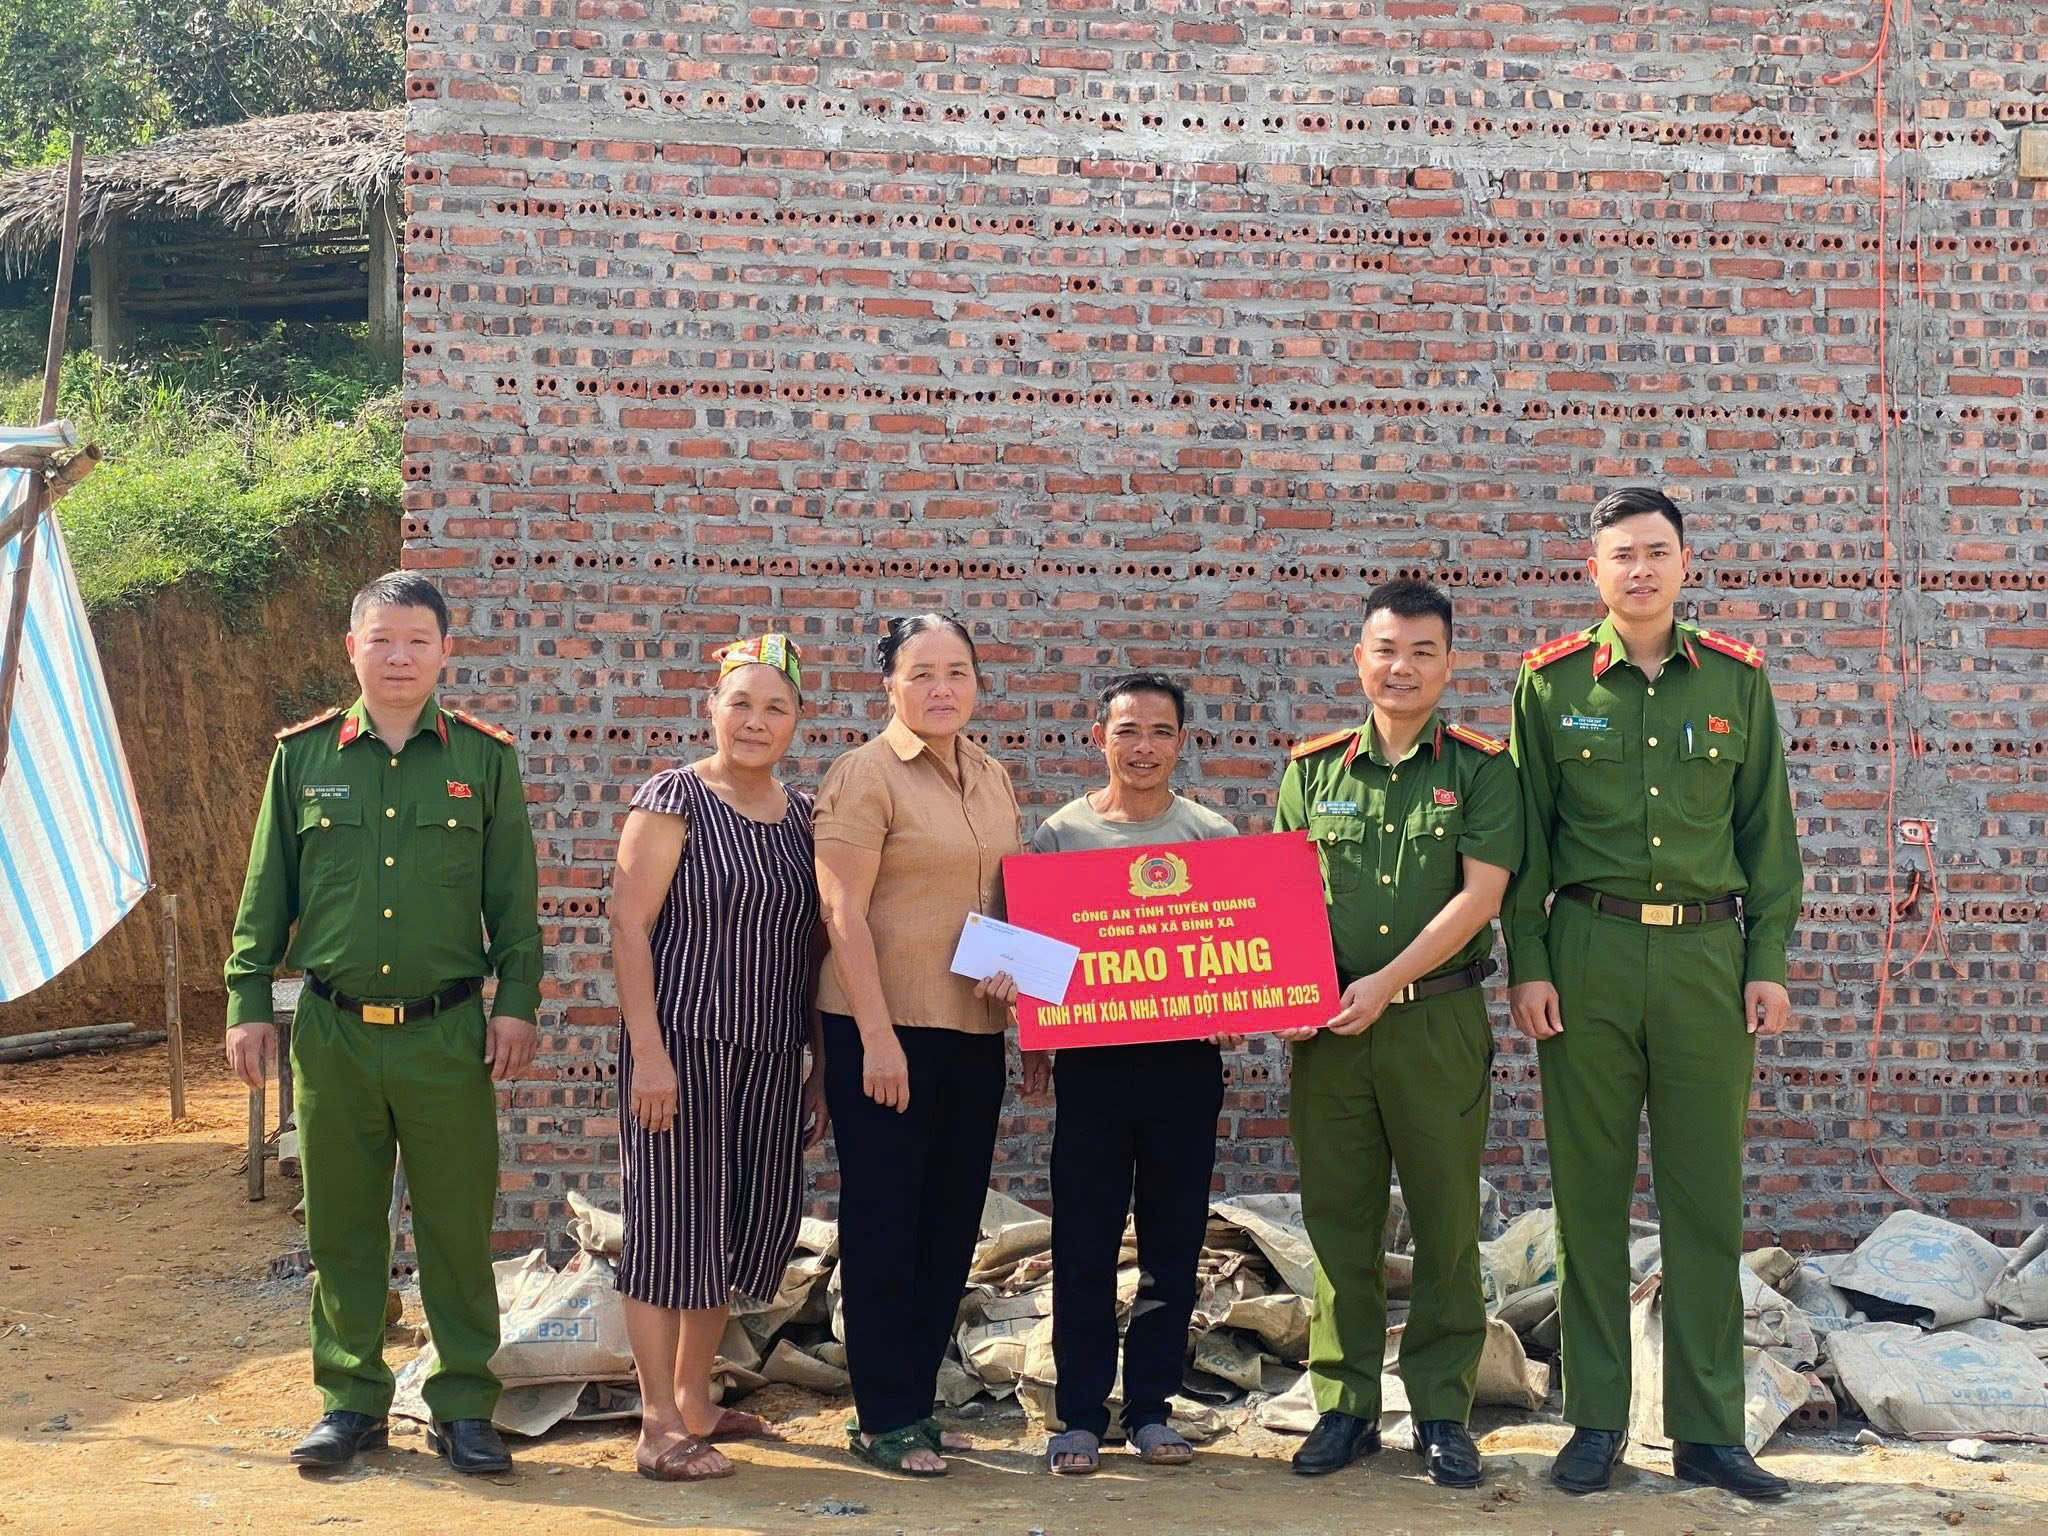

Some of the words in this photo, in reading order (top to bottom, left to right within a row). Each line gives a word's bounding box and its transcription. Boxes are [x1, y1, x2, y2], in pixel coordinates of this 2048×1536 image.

[1072, 910, 1108, 923] CÔNG
[1112, 909, 1131, 920] AN
[1168, 901, 1209, 915] TUYÊN
[1212, 898, 1257, 912] QUANG
[1098, 924, 1135, 937] CÔNG
[1138, 923, 1157, 935] AN
[1160, 920, 1178, 933] XÃ
[1217, 917, 1235, 928] XA
[1078, 946, 1168, 986] TRAO
[1177, 935, 1273, 984] TẶNG
[1037, 1005, 1071, 1026] KINH
[1073, 999, 1097, 1024] PHÍ
[1099, 997, 1128, 1023] XÓA
[1130, 994, 1160, 1020] NHÀ
[1161, 995, 1191, 1021] TẠM
[1193, 990, 1219, 1018] DỘT
[1222, 987, 1249, 1012] NÁT
[1251, 984, 1284, 1009] NĂM
[1287, 984, 1320, 1006] 2025
[538, 1323, 579, 1337] PCB
